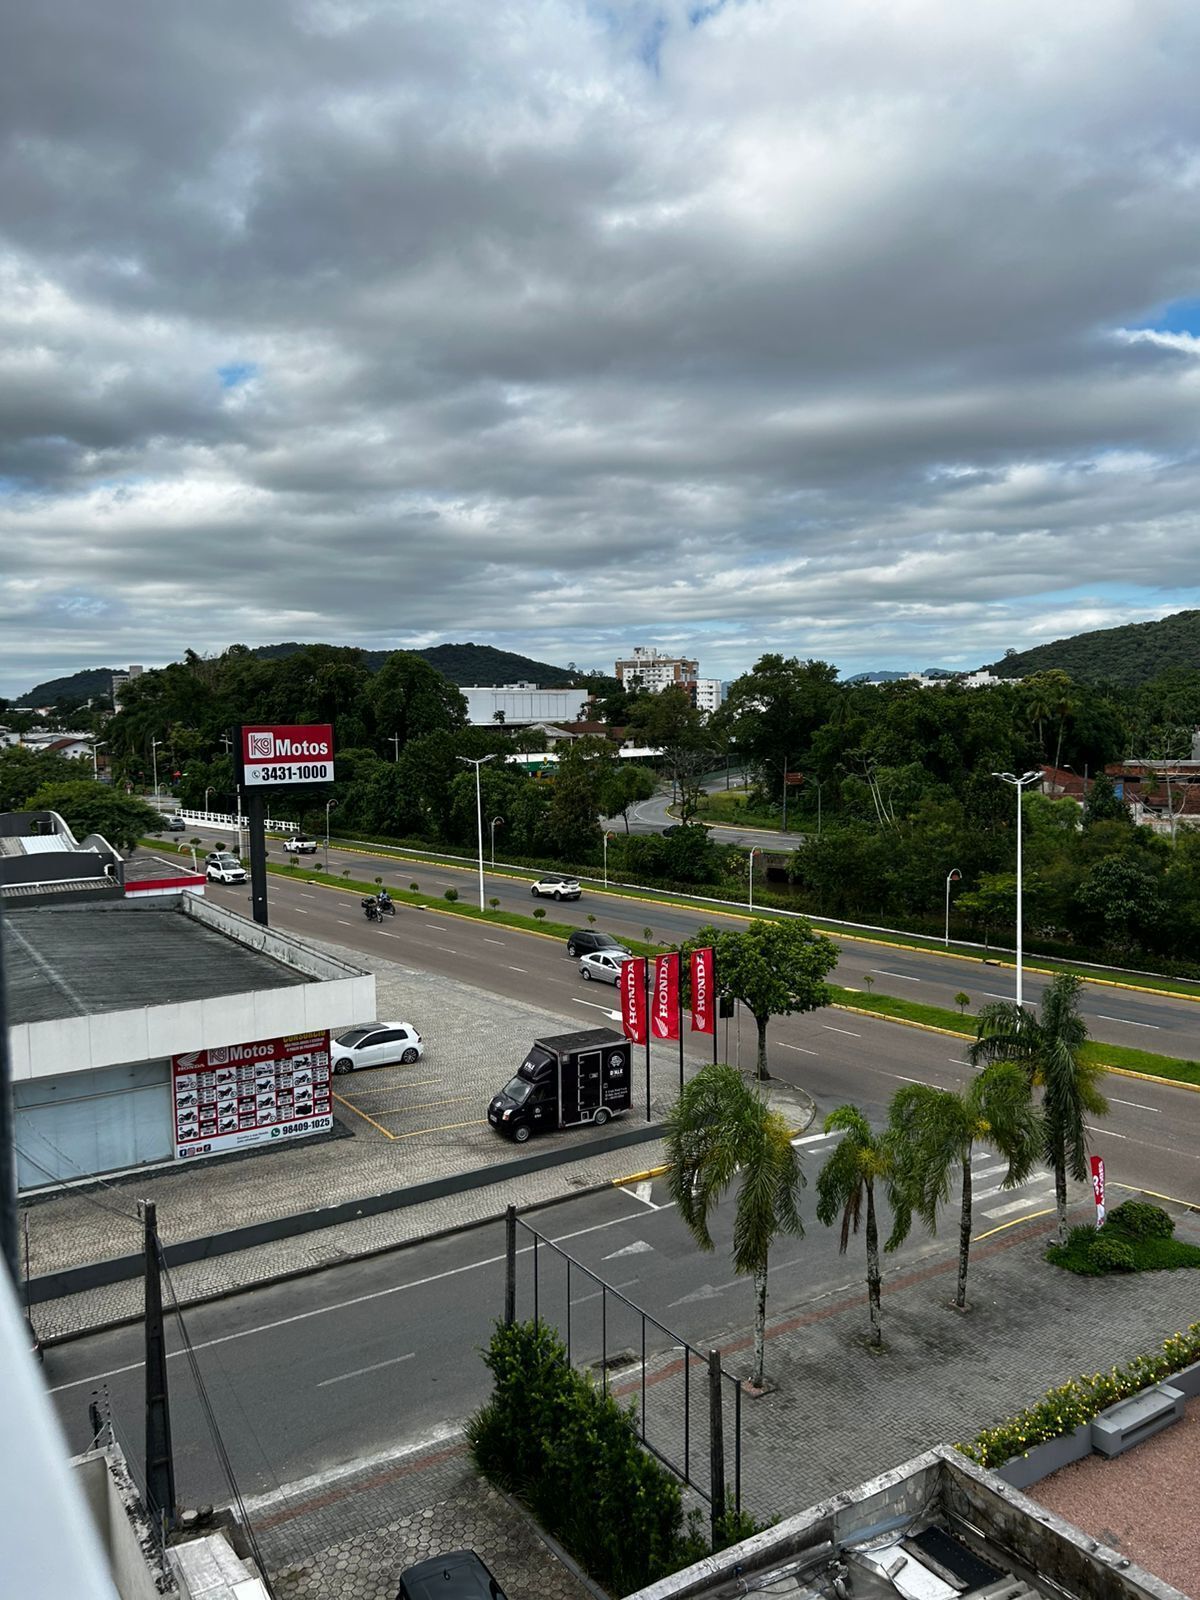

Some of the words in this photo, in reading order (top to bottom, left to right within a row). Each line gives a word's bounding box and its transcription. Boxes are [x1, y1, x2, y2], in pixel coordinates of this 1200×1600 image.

[275, 739, 329, 756] Motos
[261, 765, 327, 781] 3431-1000
[659, 957, 670, 1018] HONDA
[696, 952, 706, 1012] HONDA
[627, 962, 638, 1024] HONDA
[230, 1043, 275, 1061] Motos
[177, 1064, 205, 1072] HONDA
[282, 1118, 330, 1136] 98409-1025
